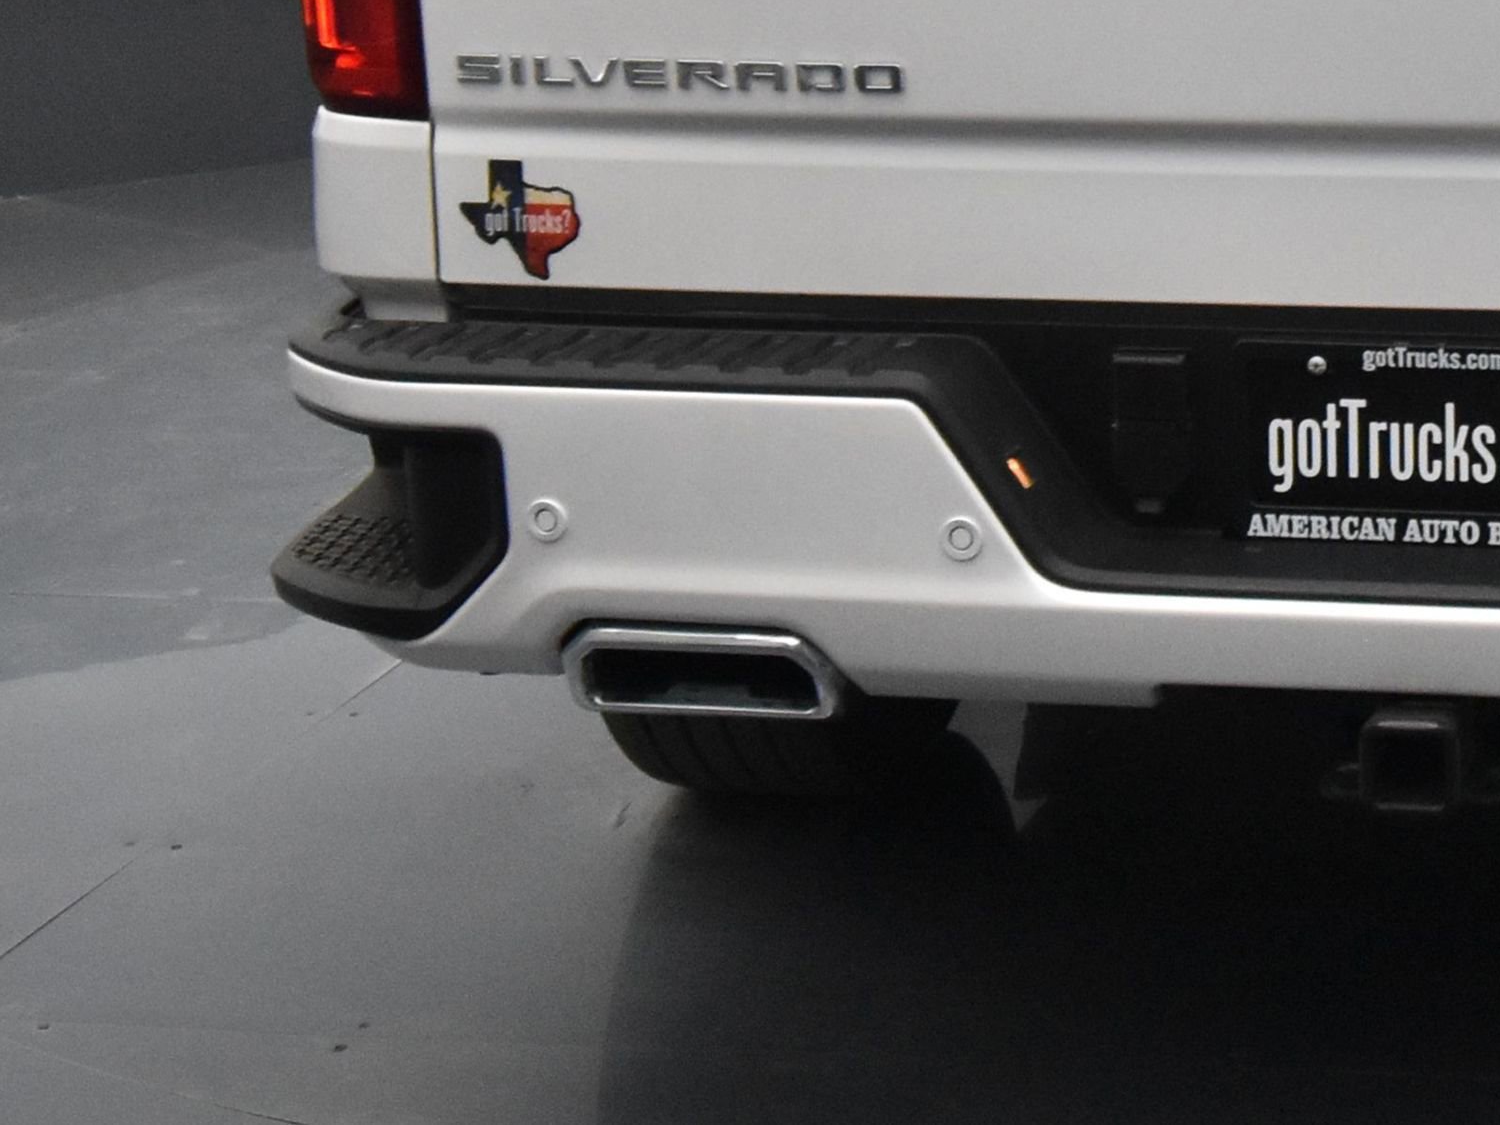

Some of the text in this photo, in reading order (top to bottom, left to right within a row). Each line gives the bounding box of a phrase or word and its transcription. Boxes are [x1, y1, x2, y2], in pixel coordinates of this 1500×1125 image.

[457, 54, 906, 94] SILVERADO
[1247, 513, 1396, 543] AMERICAN
[1403, 518, 1480, 546] AUTO
